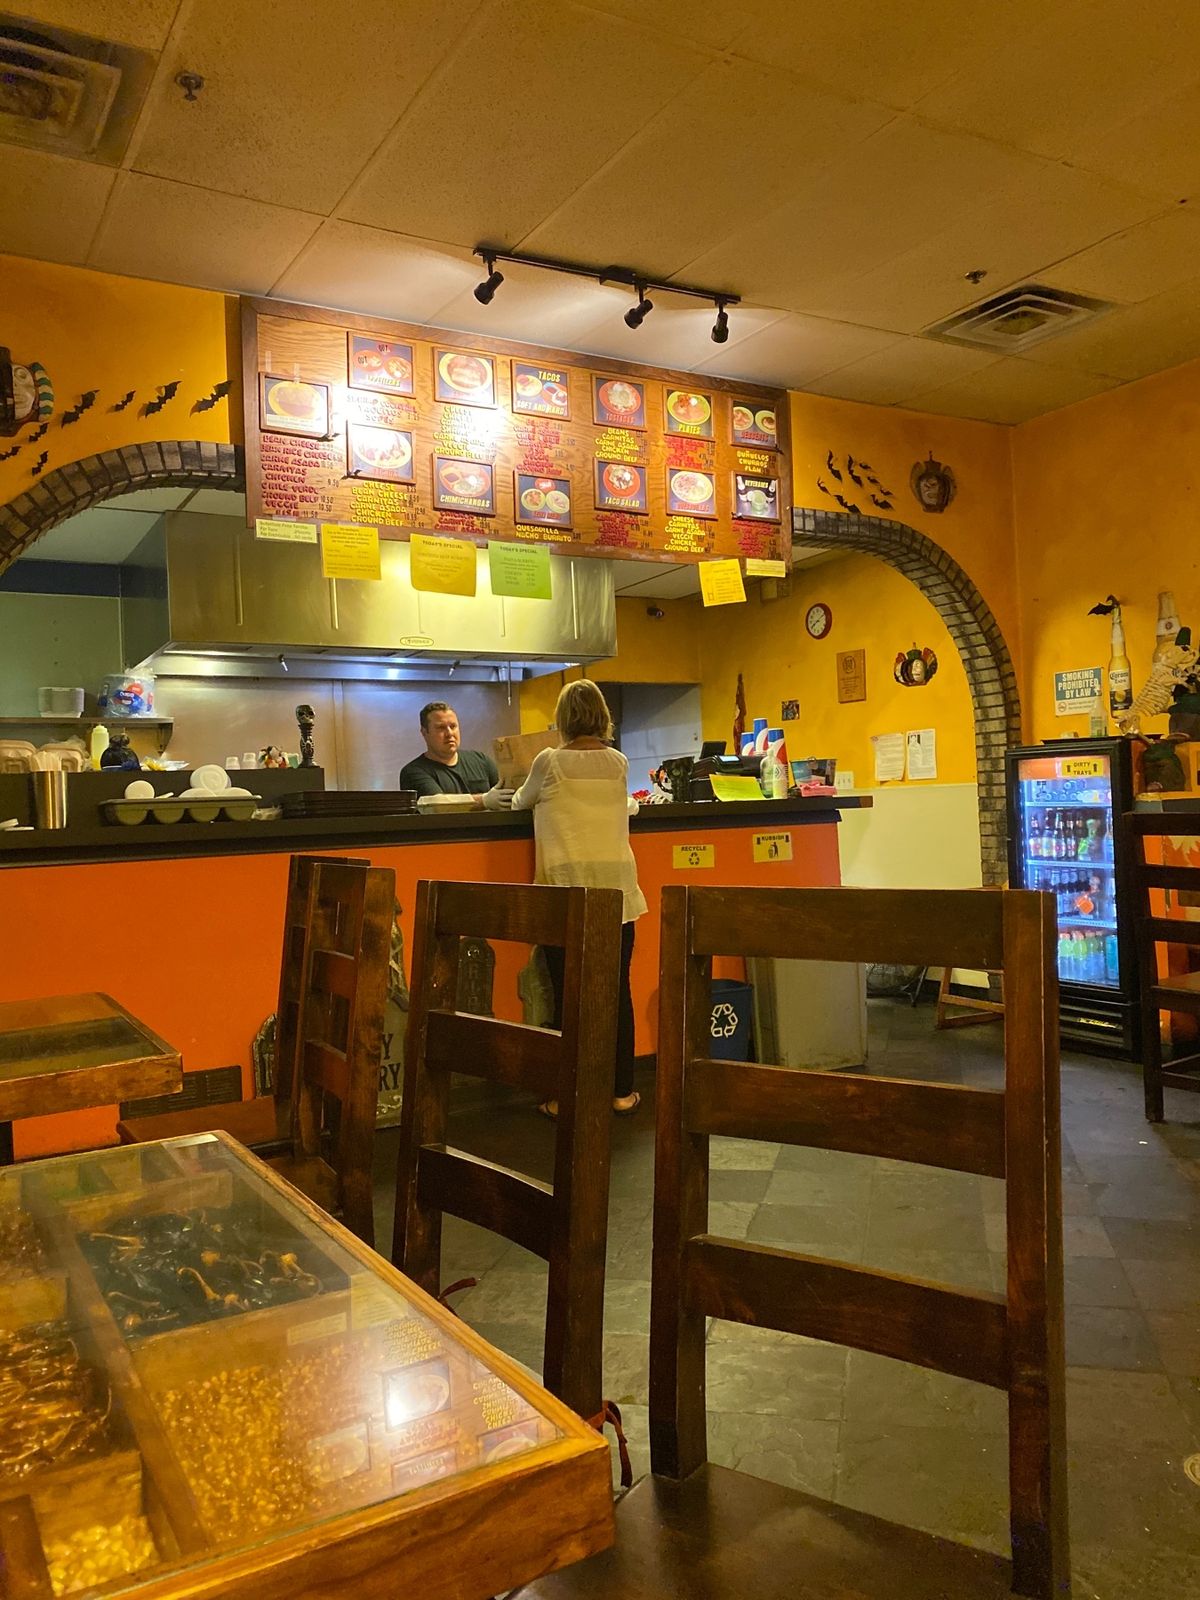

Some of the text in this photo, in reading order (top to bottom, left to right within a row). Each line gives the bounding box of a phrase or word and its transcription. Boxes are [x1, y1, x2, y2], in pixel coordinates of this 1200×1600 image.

[538, 370, 561, 382] TACOS
[678, 424, 701, 435] PLATES
[601, 433, 635, 444] CARNITAS
[291, 458, 320, 468] ASADA
[261, 463, 307, 476] CARNITAS
[363, 481, 396, 491] CHEESE
[351, 486, 375, 496] BEAN
[377, 490, 409, 501] CHEESE
[356, 495, 400, 506] CARNITAS
[440, 494, 491, 508] CHIMICHANGAS
[604, 496, 641, 508] TACO SALAD
[350, 502, 377, 511] CARNE
[379, 505, 407, 514] ASADA
[355, 509, 392, 518] CHICKEN
[672, 515, 694, 523] CHEESE
[515, 524, 560, 535] QUESADILLA
[668, 520, 699, 530] CARNITAS
[515, 531, 539, 540] NACHO
[543, 533, 572, 543] BURRITO
[1062, 670, 1094, 682] SMOKING
[1109, 671, 1129, 681] Corona
[1058, 678, 1099, 691] PROHIBITED
[1065, 688, 1092, 698] BY LAW
[382, 1033, 394, 1060] Y
[378, 1062, 401, 1091] RY
